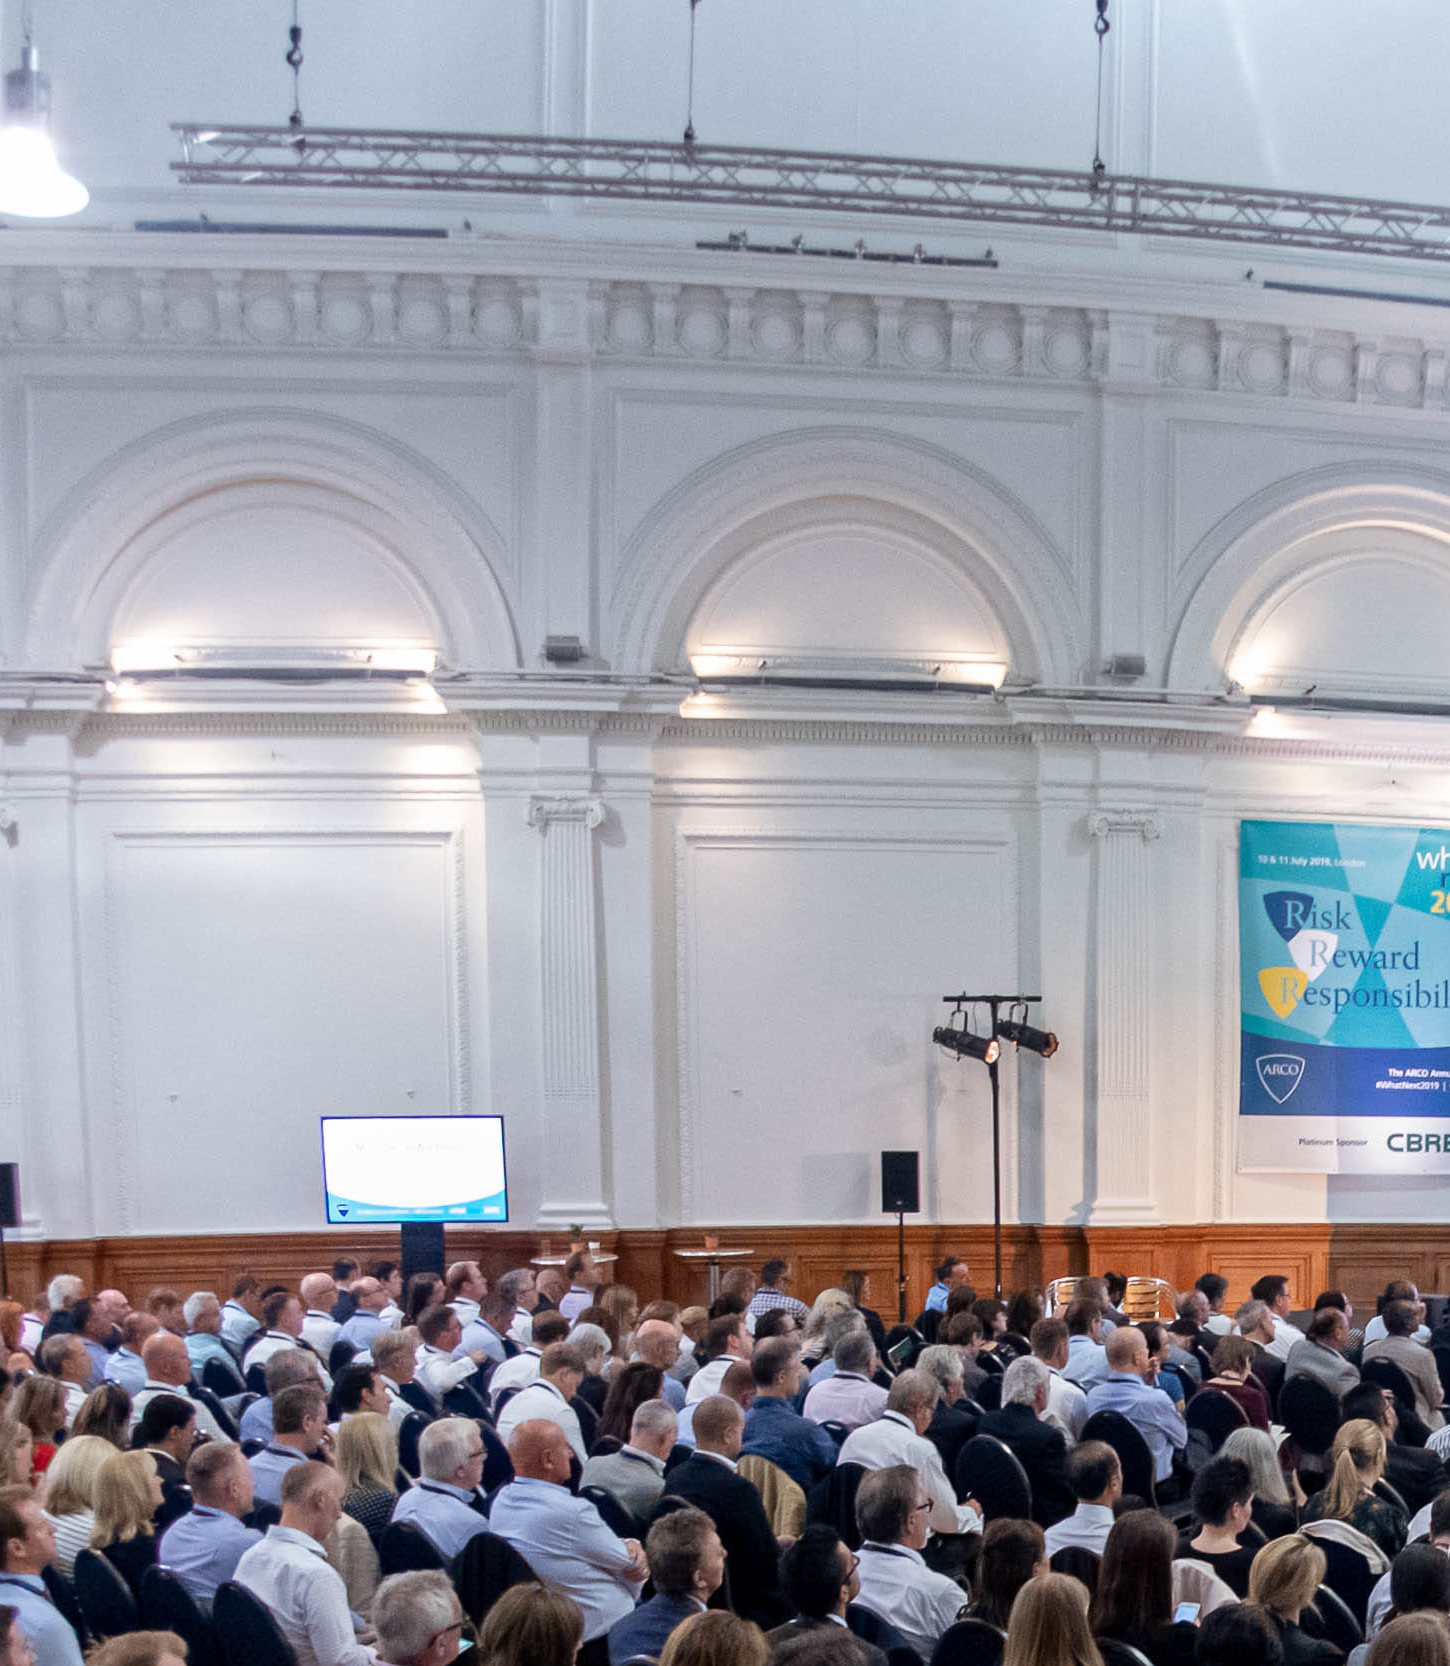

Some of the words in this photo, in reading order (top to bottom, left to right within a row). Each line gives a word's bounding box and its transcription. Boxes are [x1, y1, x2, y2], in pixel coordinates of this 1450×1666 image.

[1290, 856, 1307, 867] July
[1284, 900, 1353, 931] Risk
[1310, 939, 1420, 971] Reward
[1263, 1063, 1300, 1077] ARCO
[1388, 1068, 1403, 1077] The
[1405, 1069, 1428, 1078] ARCO
[1299, 1138, 1334, 1146] Platinum
[1336, 1138, 1368, 1148] Sponsor
